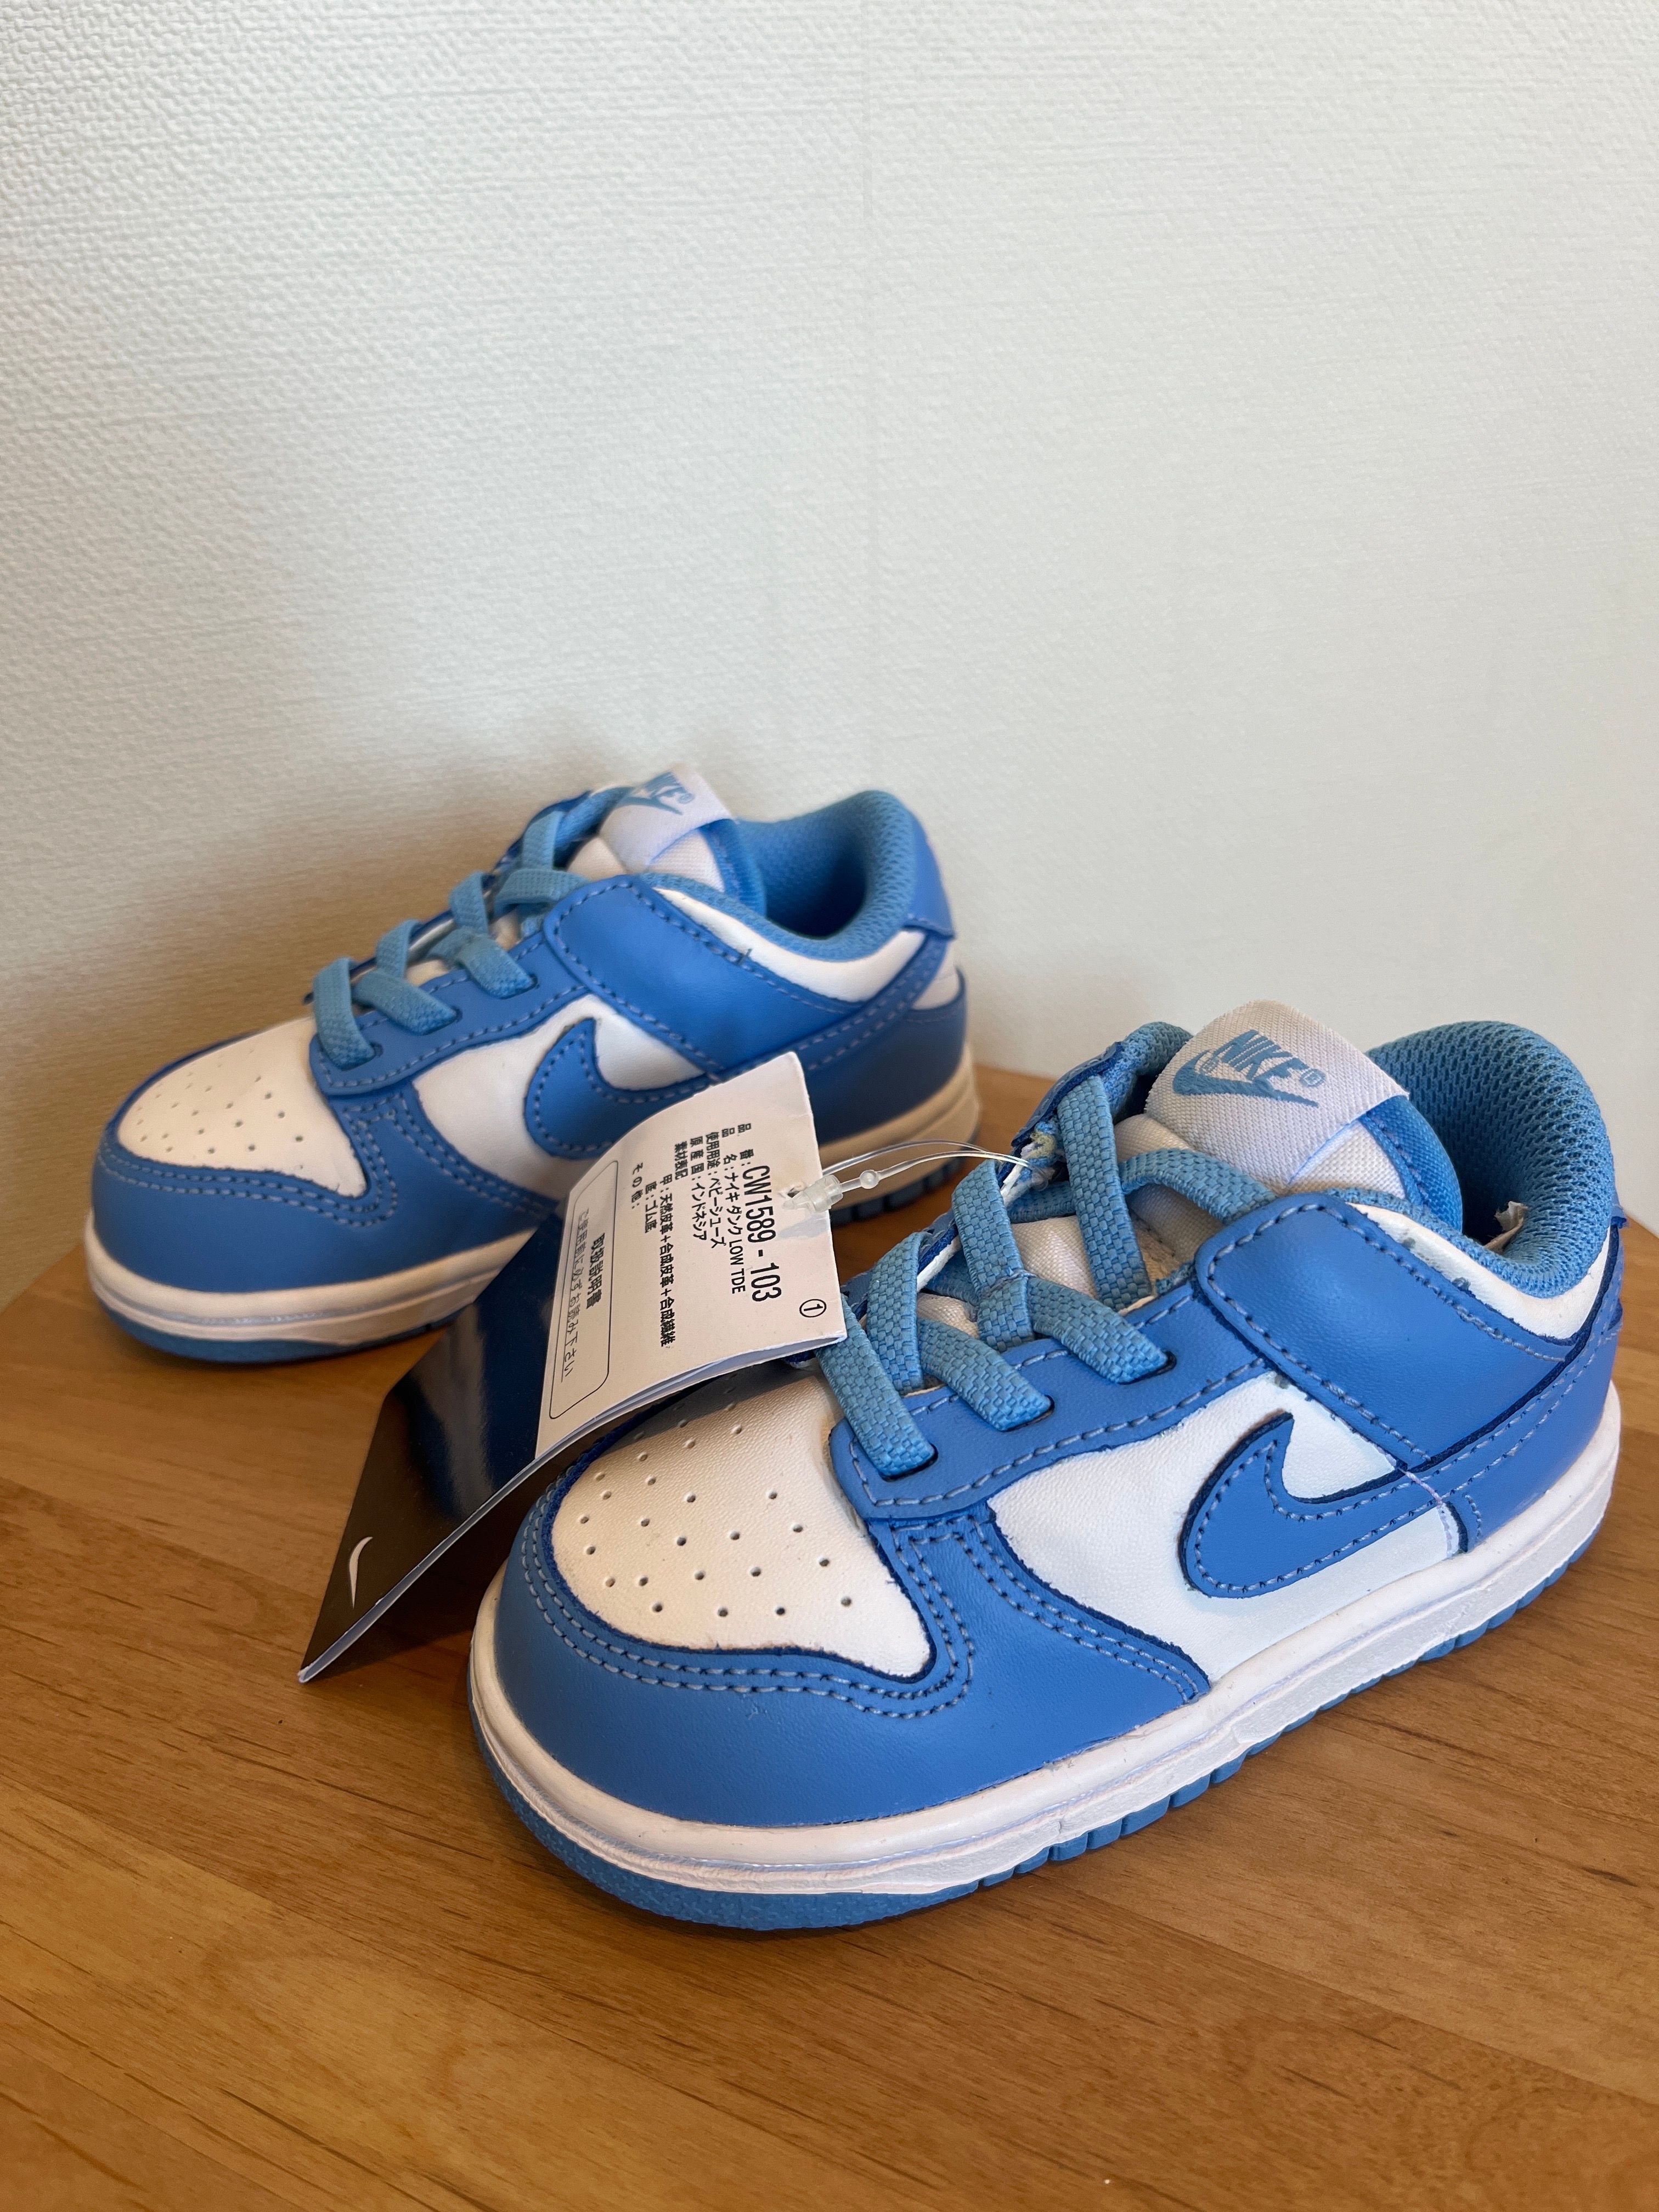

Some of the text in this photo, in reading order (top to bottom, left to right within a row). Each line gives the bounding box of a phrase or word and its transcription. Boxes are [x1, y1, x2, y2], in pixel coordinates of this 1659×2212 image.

[1218, 1029, 1311, 1085] NIKE
[675, 1141, 689, 1181] 素材表記
[725, 1206, 743, 1235] ダンク
[742, 1165, 776, 1243] CW1589
[586, 1233, 605, 1310] 取扱説明書
[729, 1238, 744, 1266] LOW
[731, 1268, 746, 1294] TDE
[751, 1262, 782, 1302] 103
